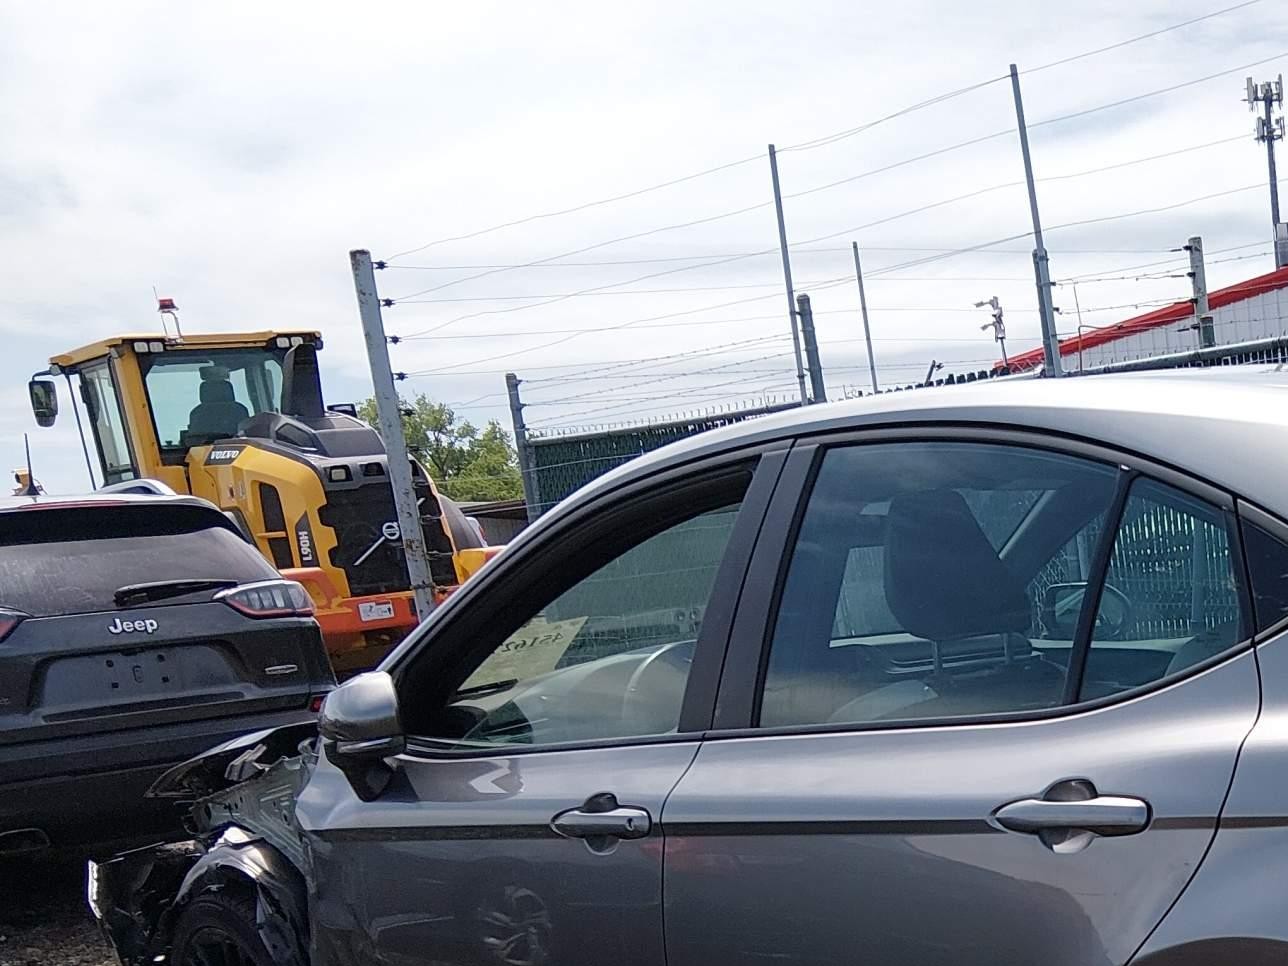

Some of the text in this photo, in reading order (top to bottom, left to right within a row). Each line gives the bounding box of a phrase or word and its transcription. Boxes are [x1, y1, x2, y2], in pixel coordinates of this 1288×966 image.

[210, 450, 240, 460] VOLVO
[298, 530, 312, 561] L90H
[108, 618, 158, 633] Jeep
